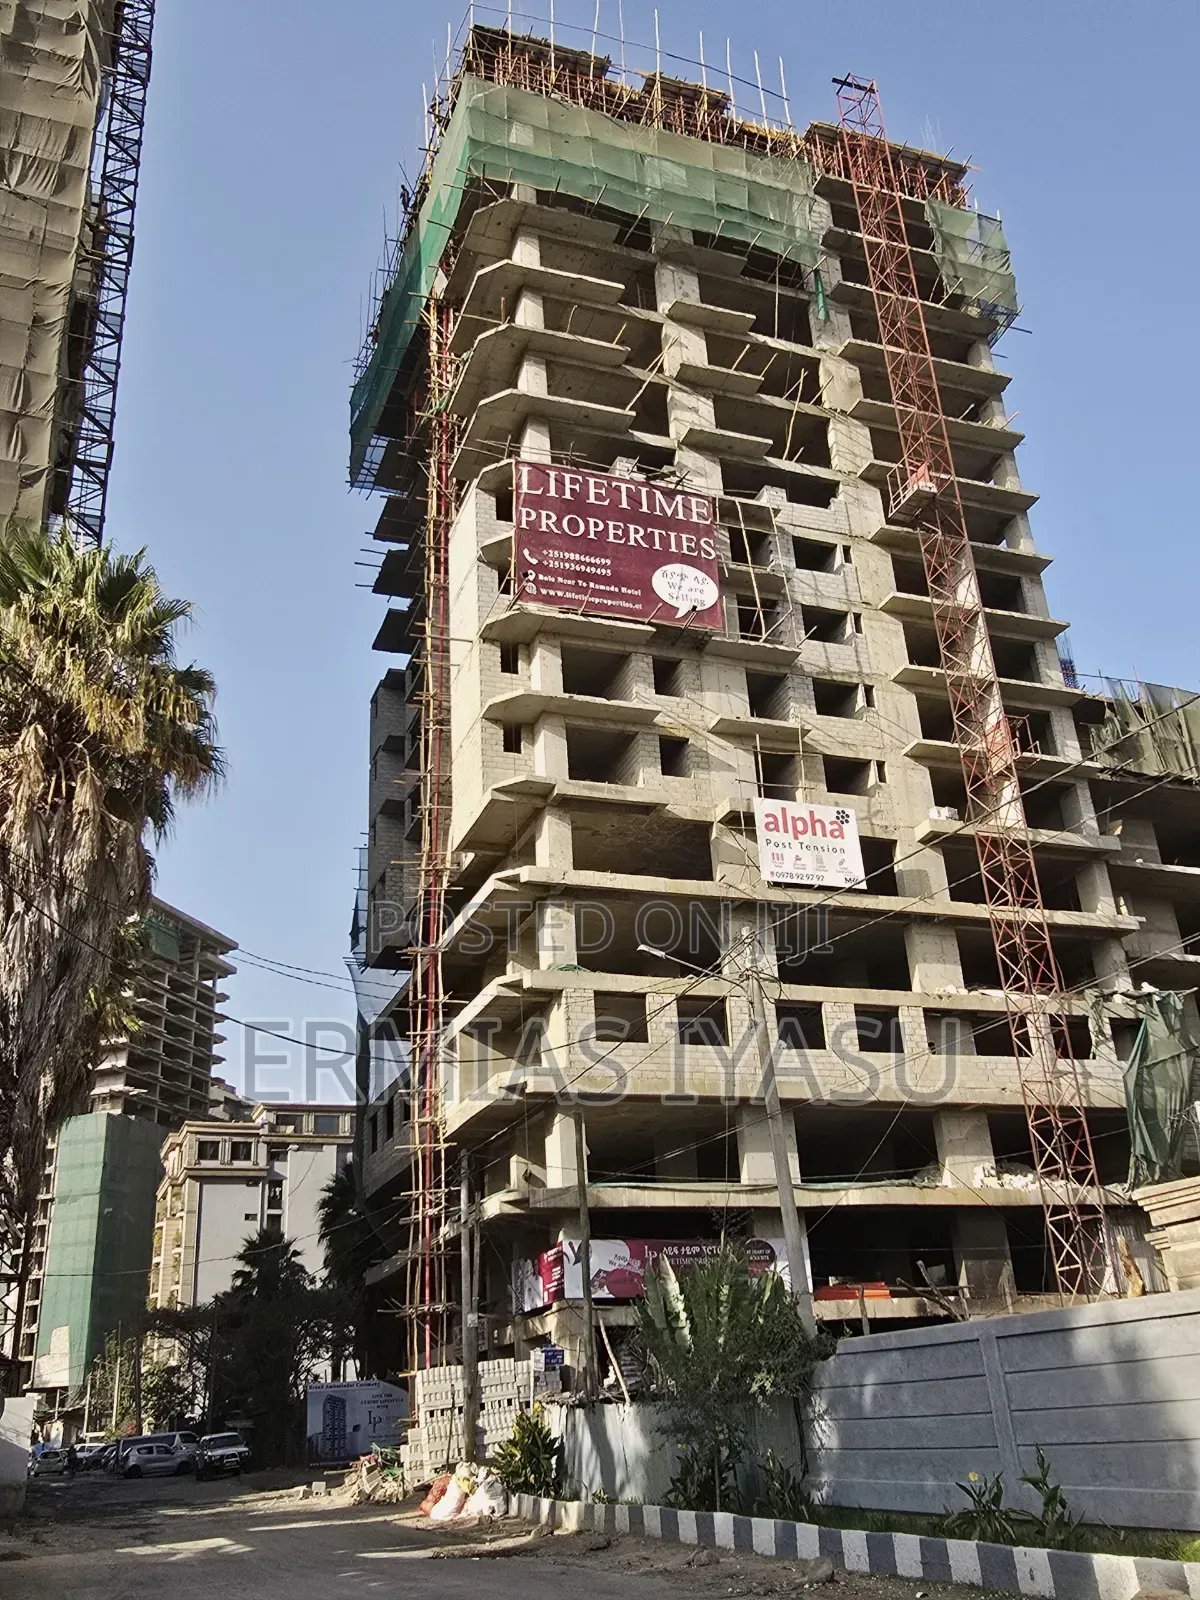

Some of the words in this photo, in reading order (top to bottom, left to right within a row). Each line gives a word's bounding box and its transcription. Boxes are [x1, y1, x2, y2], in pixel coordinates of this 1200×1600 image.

[518, 466, 712, 525] LIFETIME
[519, 507, 716, 560] PROPERTIES
[620, 586, 642, 596] Hotel
[667, 581, 683, 591] We
[688, 586, 705, 595] are
[668, 592, 706, 607] Selling
[763, 806, 845, 841] alpha
[765, 838, 792, 850] Post
[798, 841, 846, 854] Tension
